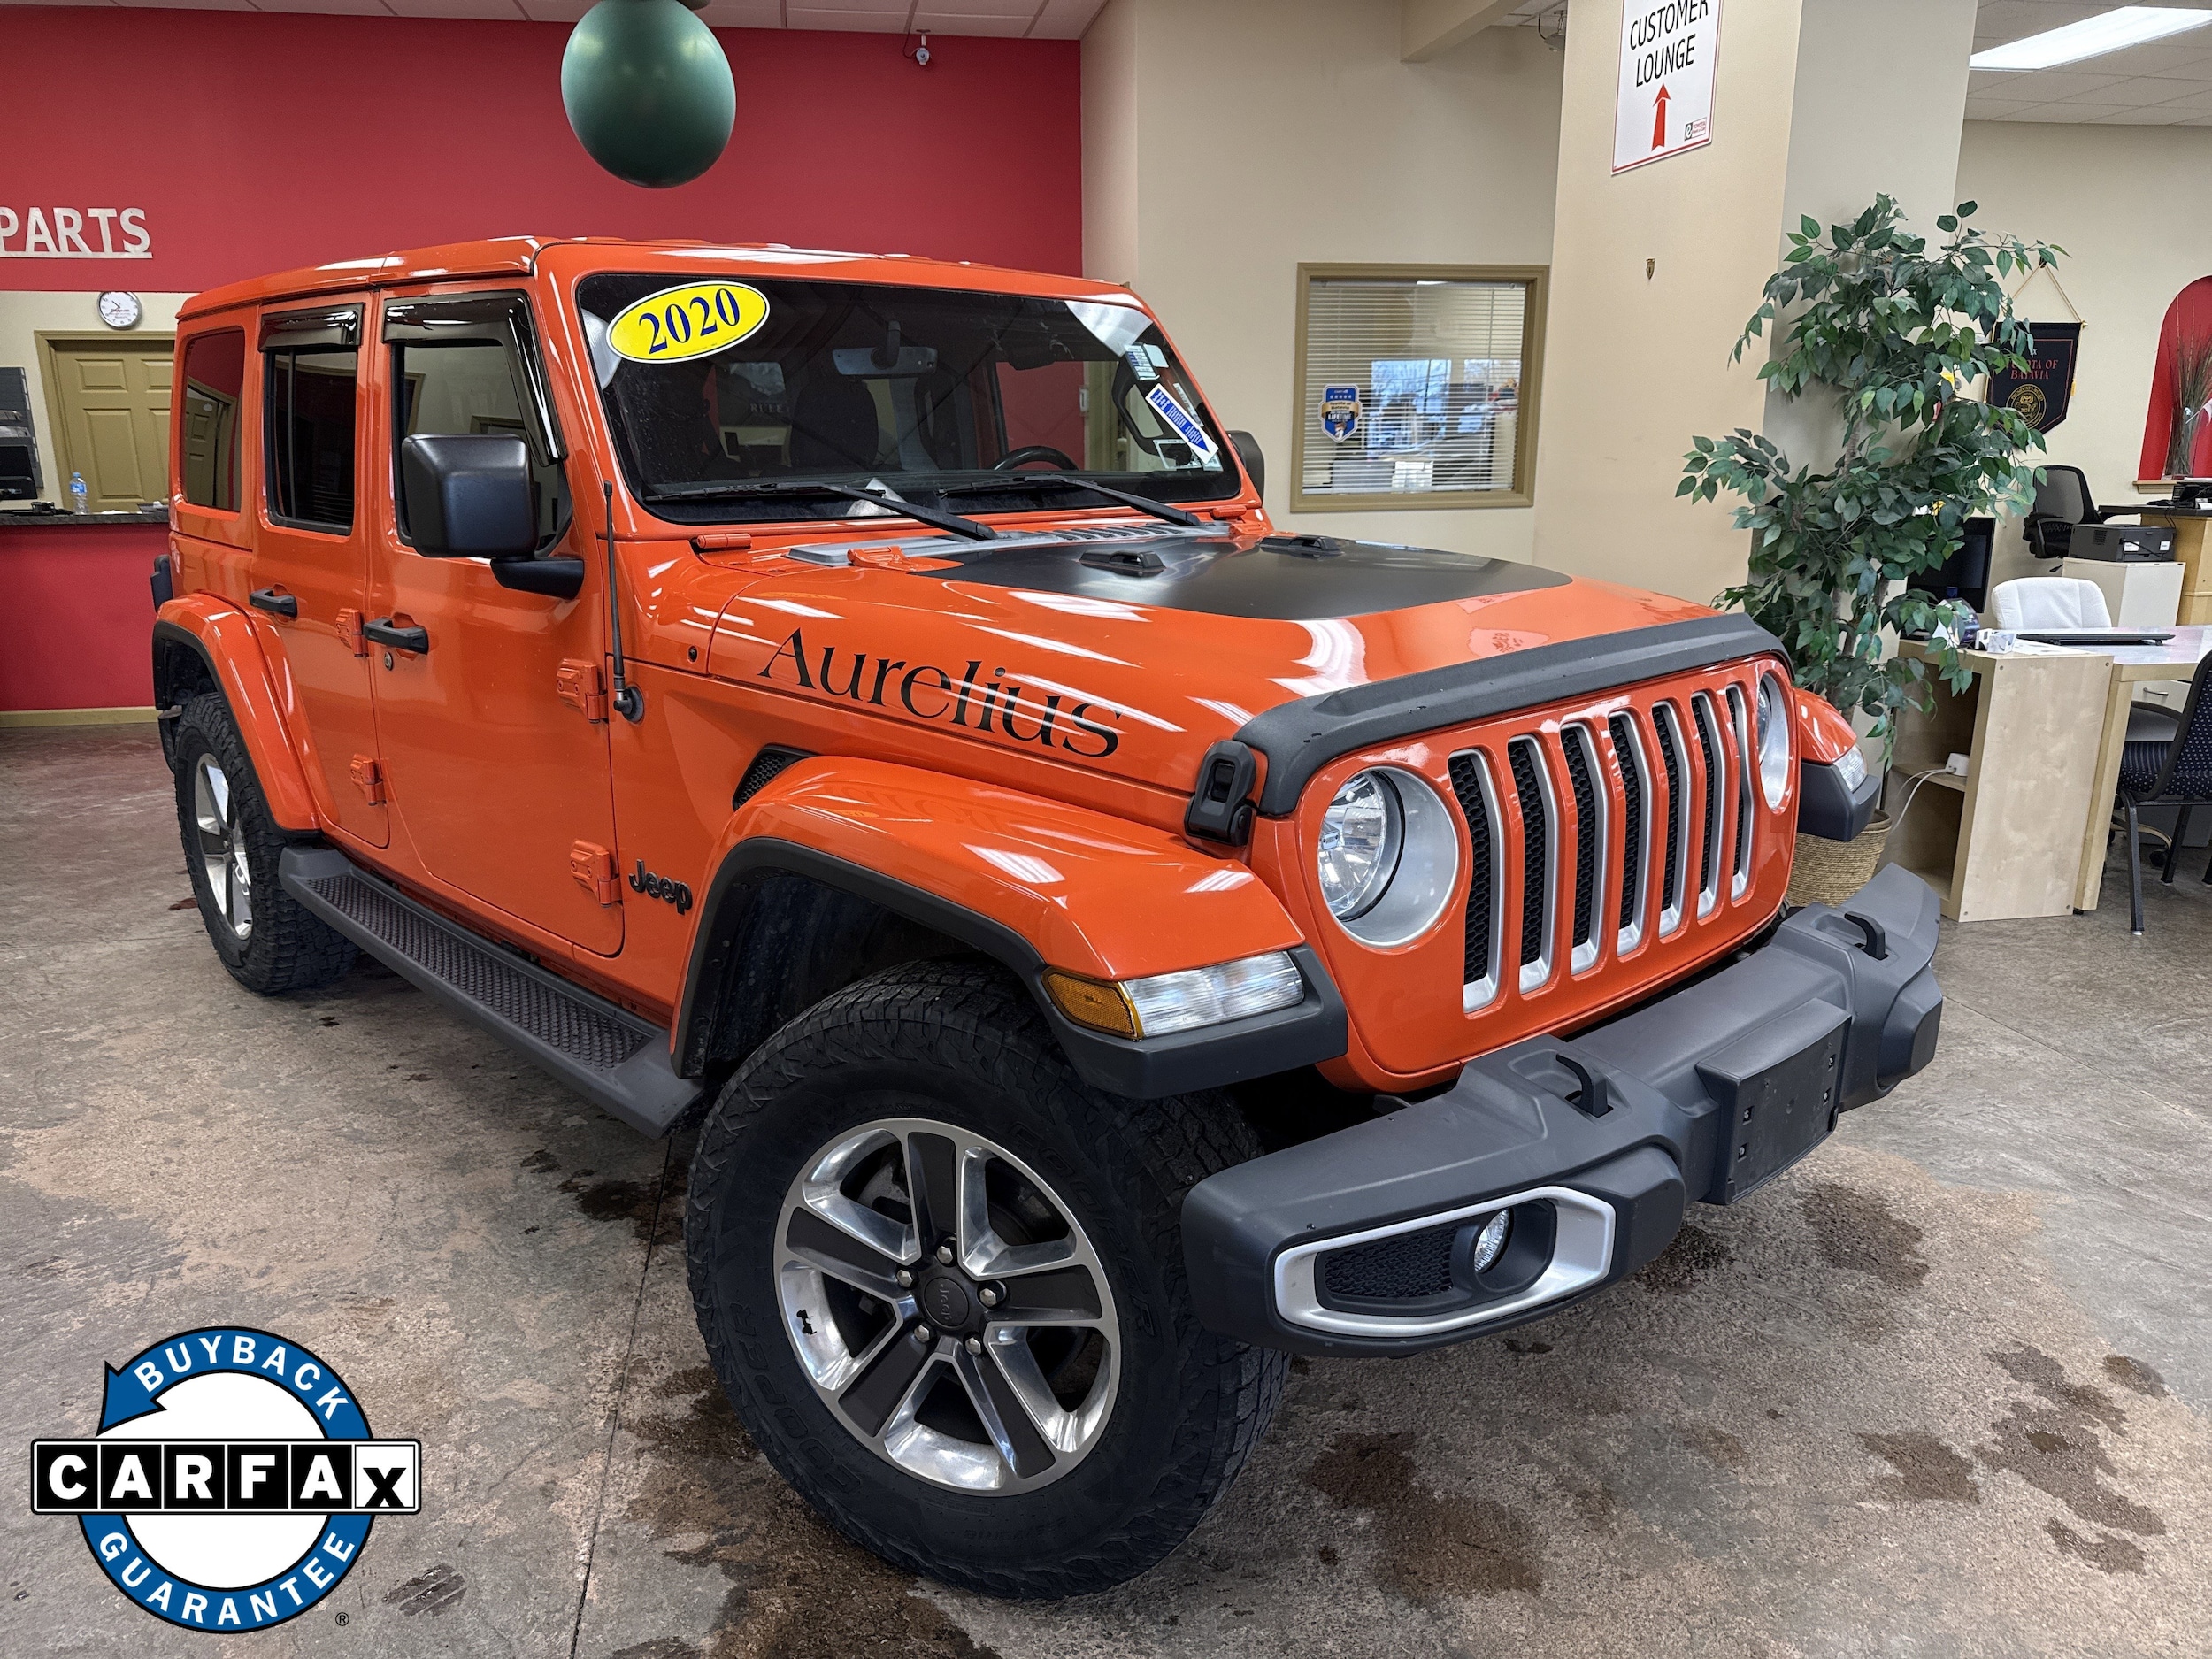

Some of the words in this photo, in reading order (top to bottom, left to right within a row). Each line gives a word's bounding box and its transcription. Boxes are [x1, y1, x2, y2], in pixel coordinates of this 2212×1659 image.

[1630, 0, 1709, 50] CUSTOMER
[1636, 34, 1696, 88] LOUNGE
[0, 206, 152, 258] PARTS
[638, 288, 740, 355] 2020
[2045, 359, 2059, 370] OF
[757, 626, 1124, 759] Aurelius
[628, 858, 693, 916] Jeep
[1007, 1121, 1156, 1337] COOPER
[729, 1302, 861, 1495] COOPER
